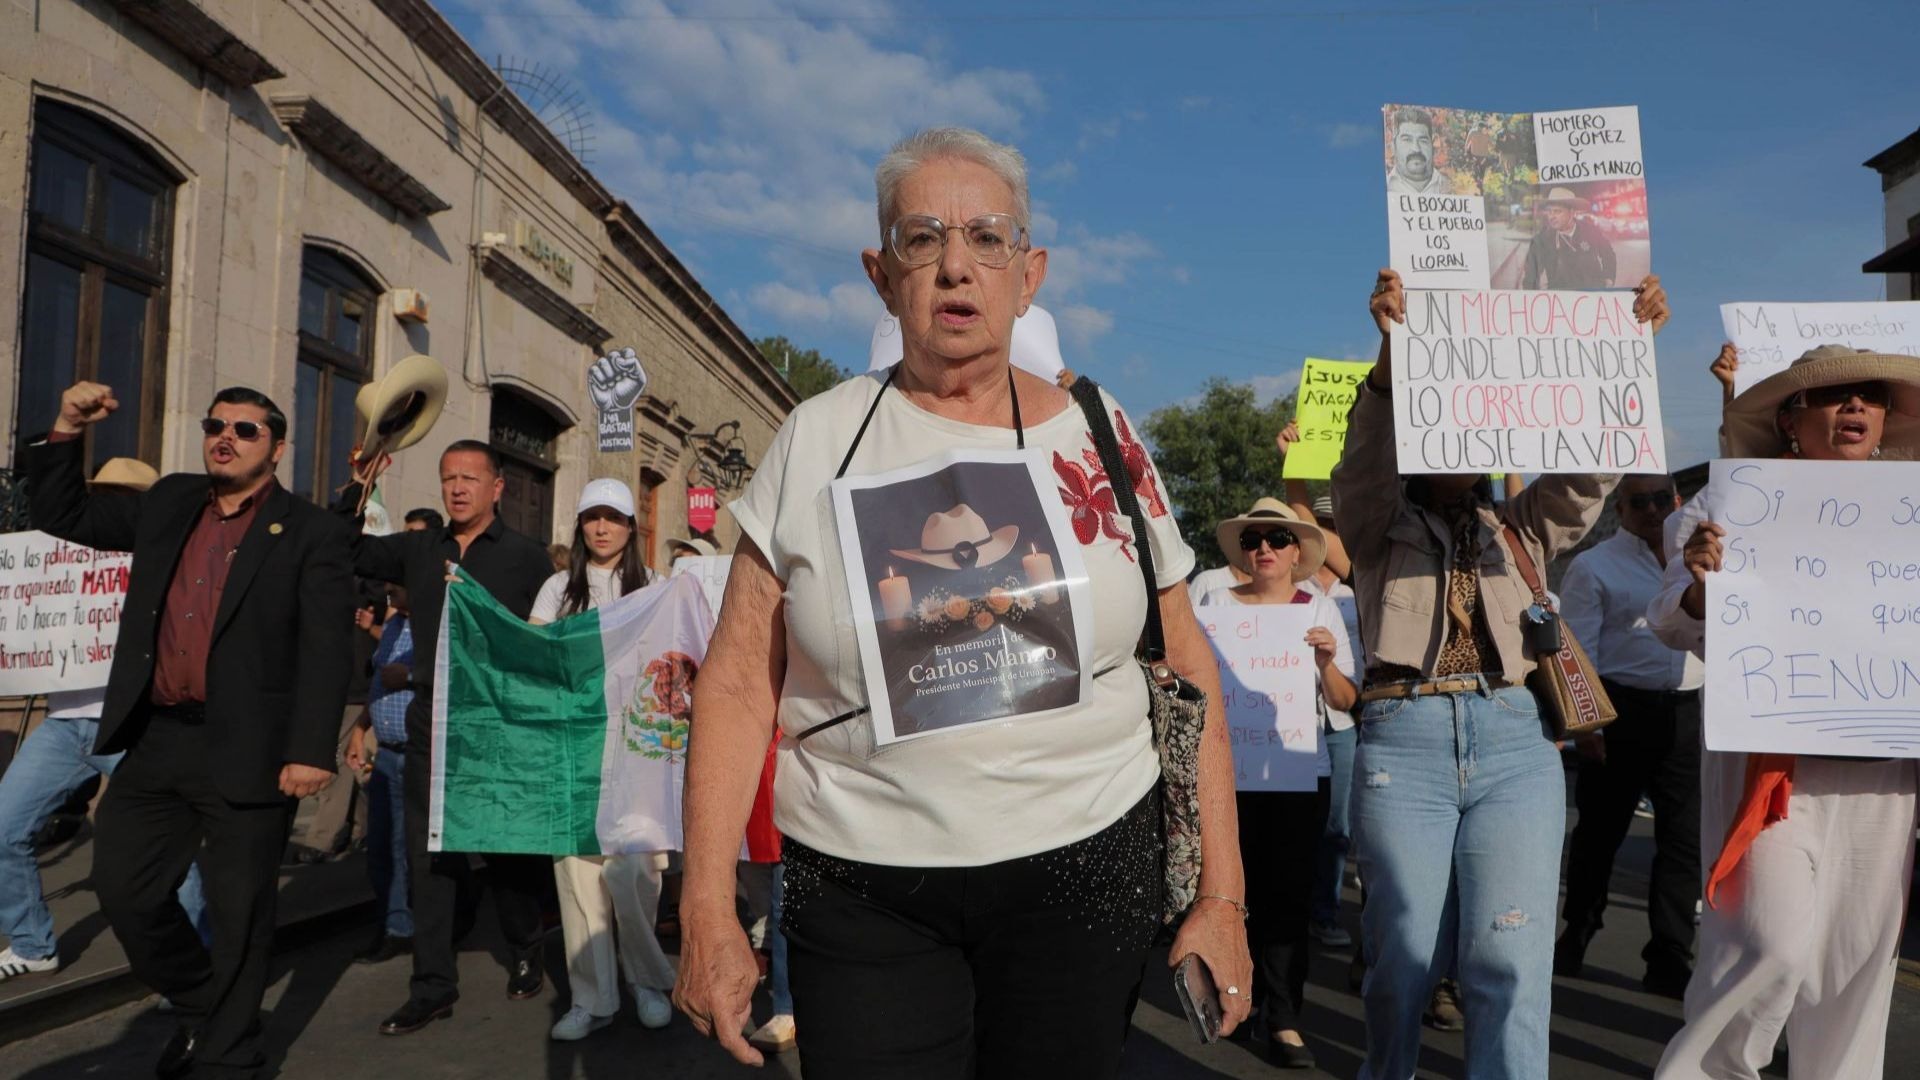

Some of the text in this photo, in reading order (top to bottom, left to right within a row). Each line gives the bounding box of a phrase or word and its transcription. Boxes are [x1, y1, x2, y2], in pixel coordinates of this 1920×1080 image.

[1540, 114, 1605, 135] HOMERO
[1568, 129, 1625, 147] GOMEZ
[1570, 149, 1583, 162] Y
[1541, 161, 1642, 181] CARLOS MANZO
[1400, 195, 1471, 214] EL BOSQUE
[1403, 217, 1484, 232] Y EL PUEBLO
[1426, 235, 1450, 250] LOS
[1405, 291, 1644, 337] UN MICHOACAN
[1736, 306, 1909, 339] Mi bienestar
[1407, 336, 1652, 381] DONDE DEFENDER
[1409, 381, 1644, 428] LO CORRECTO NO
[1421, 428, 1659, 470] CUESTE LA VIDA
[1725, 465, 1785, 526] Si
[1818, 498, 1861, 527] no
[24, 545, 41, 568] las
[1723, 536, 1757, 573] Si
[1795, 555, 1827, 578] no
[14, 569, 76, 607] organizado
[16, 605, 28, 631] lo
[33, 604, 67, 630] hacen
[73, 600, 85, 626] tu
[1236, 615, 1259, 639] el
[1790, 607, 1822, 626] no
[935, 644, 951, 656] En
[1010, 632, 1025, 643] de
[59, 648, 67, 678] y
[71, 640, 85, 665] tu
[908, 658, 979, 684] Carlos
[915, 682, 961, 697] Presidente
[962, 671, 1006, 690] Municipal
[1007, 671, 1018, 680] de
[1569, 673, 1597, 722] GUESS
